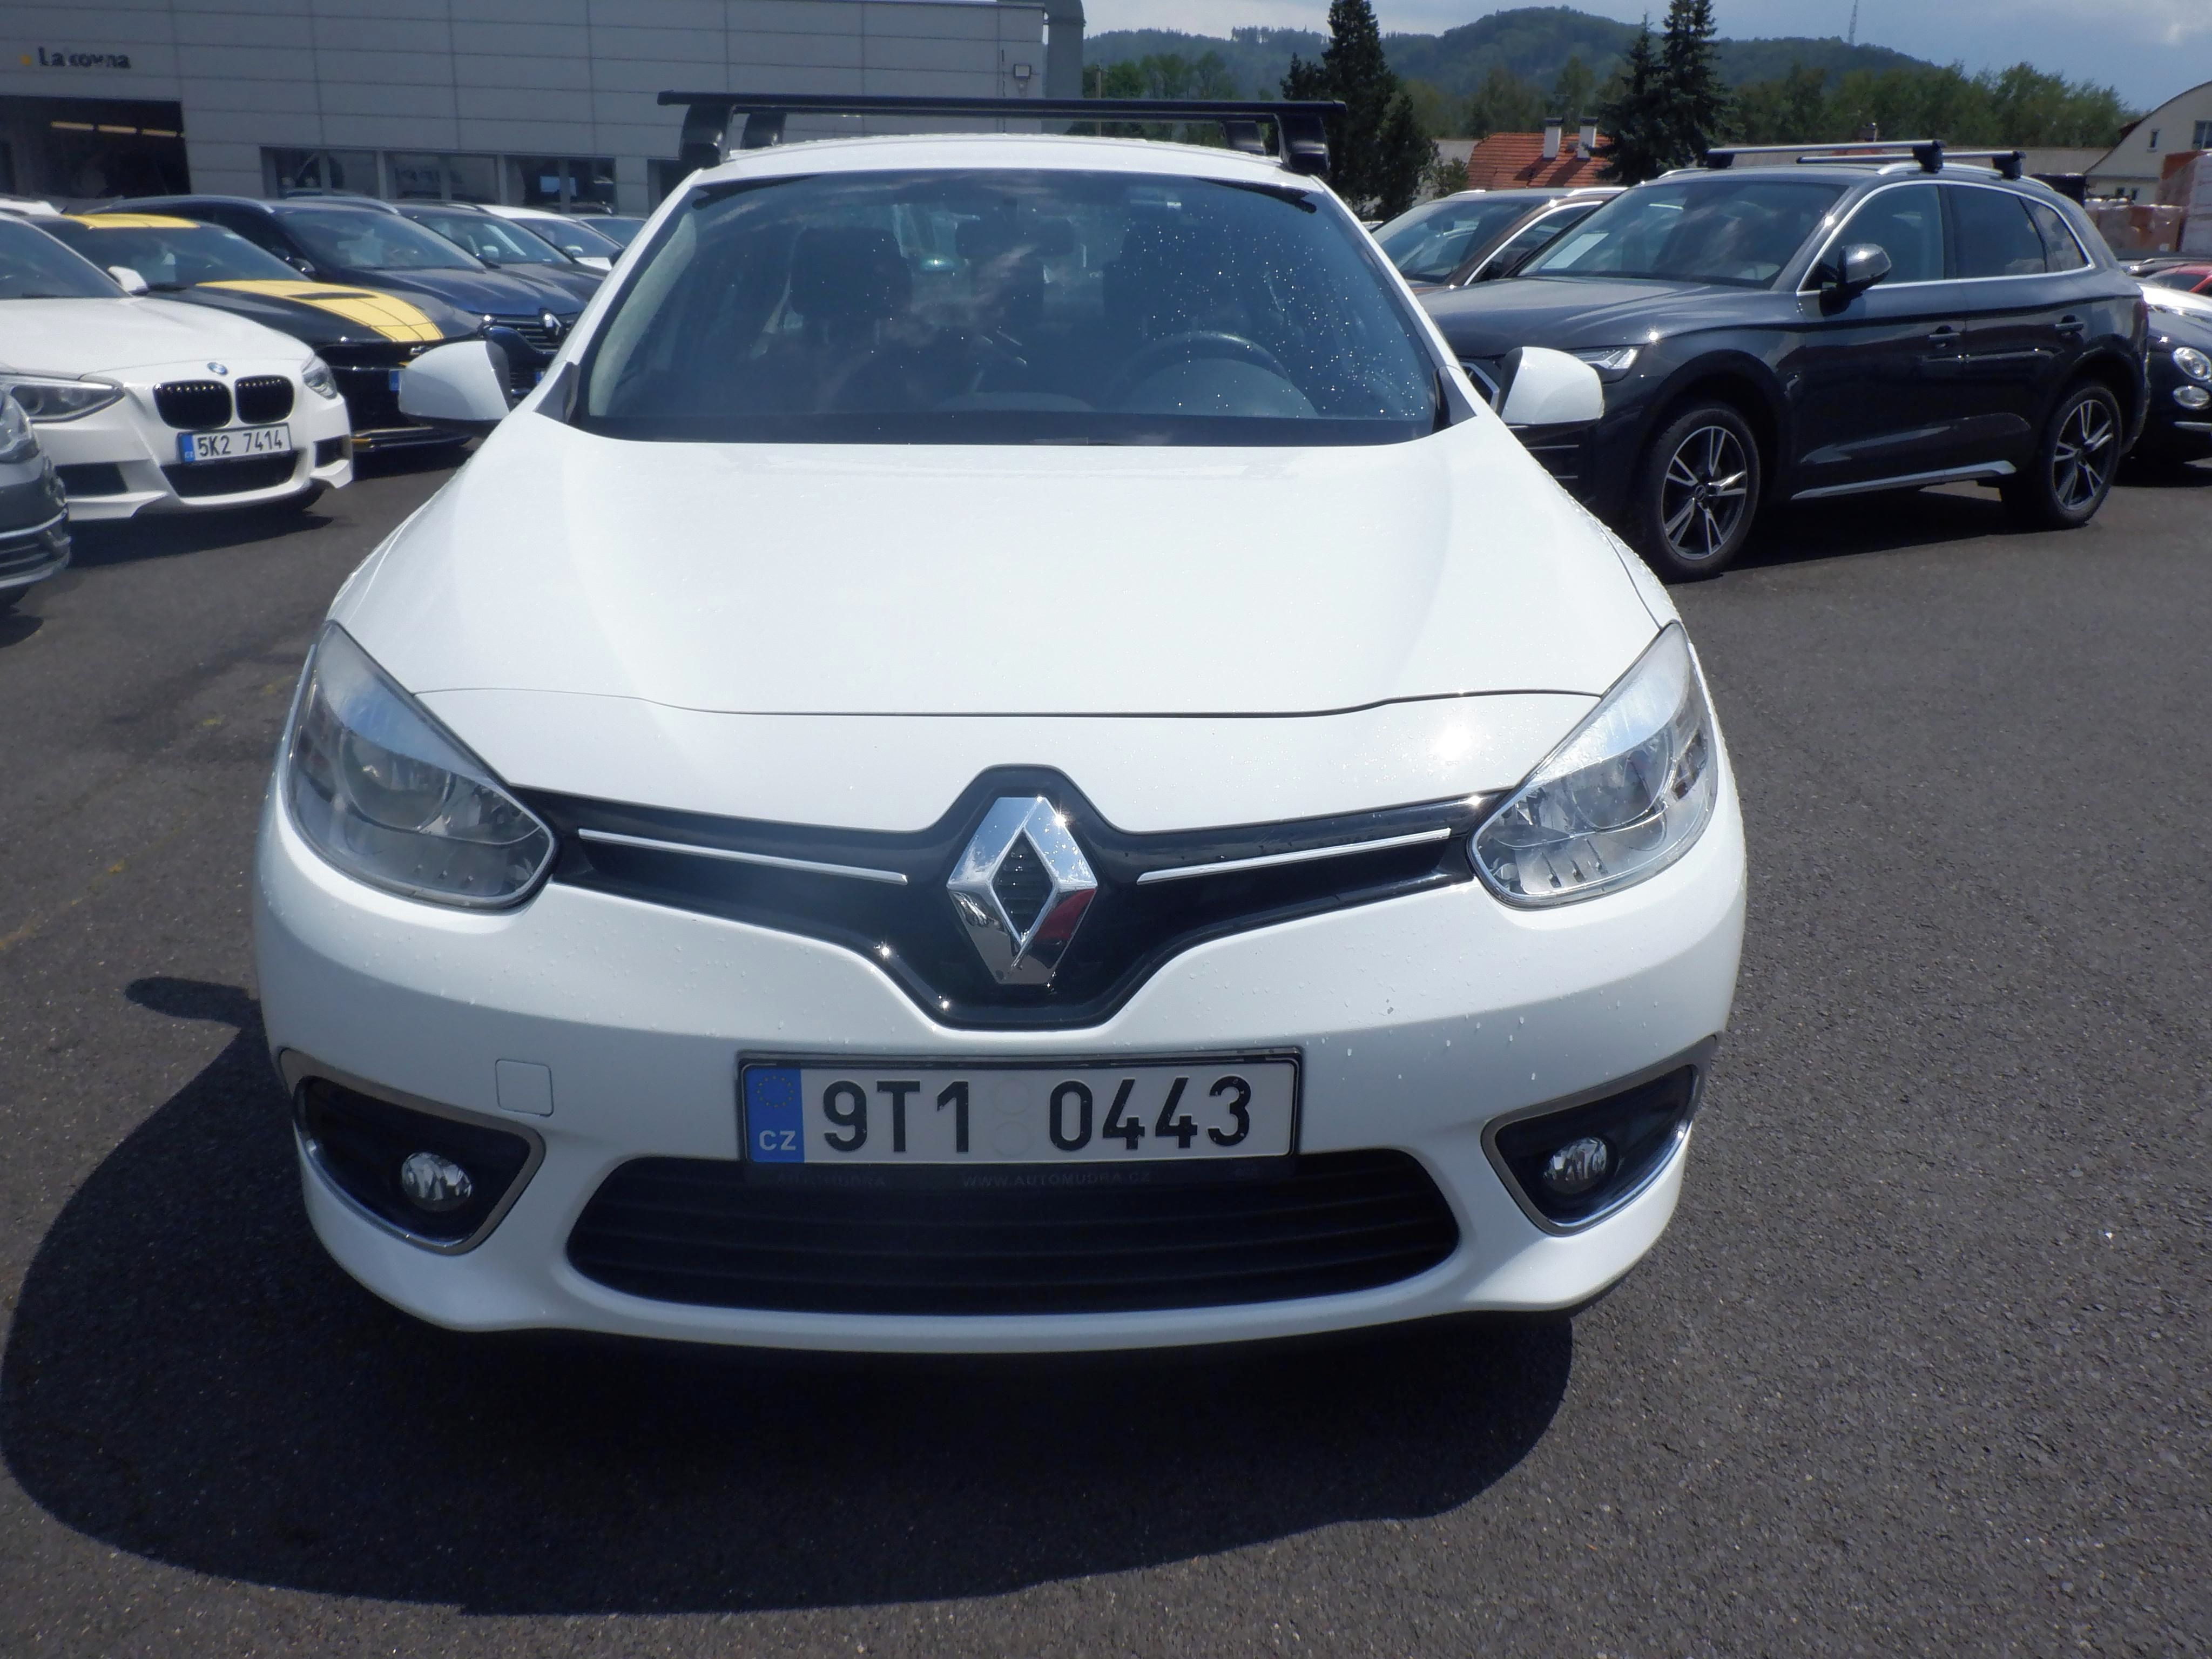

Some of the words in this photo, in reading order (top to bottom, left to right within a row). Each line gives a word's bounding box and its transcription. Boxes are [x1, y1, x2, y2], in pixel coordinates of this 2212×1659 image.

[197, 435, 231, 456] 5K2
[243, 430, 282, 453] 7414
[822, 1080, 970, 1154] 9T1
[1049, 1075, 1252, 1152] 0443
[759, 1130, 797, 1151] CZ
